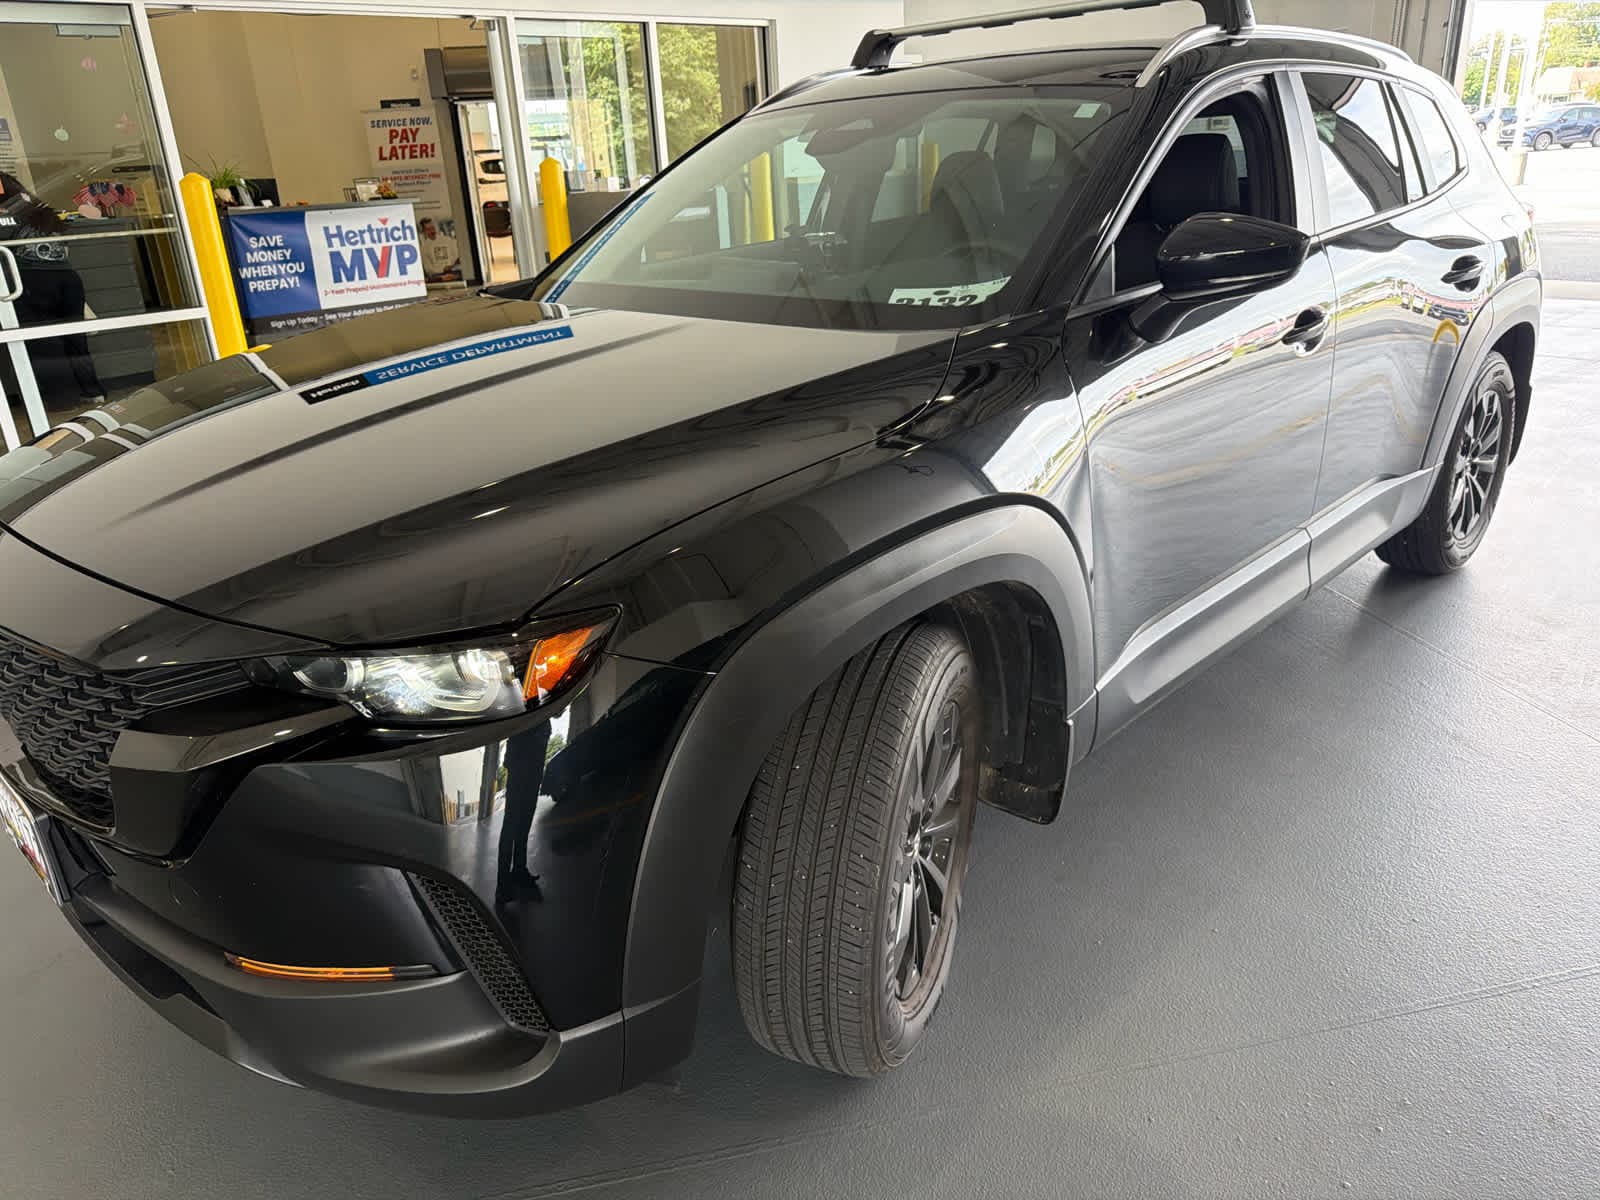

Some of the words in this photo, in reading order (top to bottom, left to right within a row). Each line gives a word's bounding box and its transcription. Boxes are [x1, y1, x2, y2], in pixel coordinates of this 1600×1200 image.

[370, 118, 407, 128] SERVICE
[389, 127, 420, 144] PAY
[378, 143, 435, 161] LATER!
[249, 234, 284, 248] SAVE
[322, 217, 415, 248] Hertrich
[246, 248, 292, 263] MONEY
[328, 244, 418, 284] MVP
[239, 264, 277, 279] WHEN
[278, 261, 305, 275] YOU
[249, 276, 300, 293] PREPAY!
[286, 319, 297, 328] Up
[297, 316, 318, 325] Today
